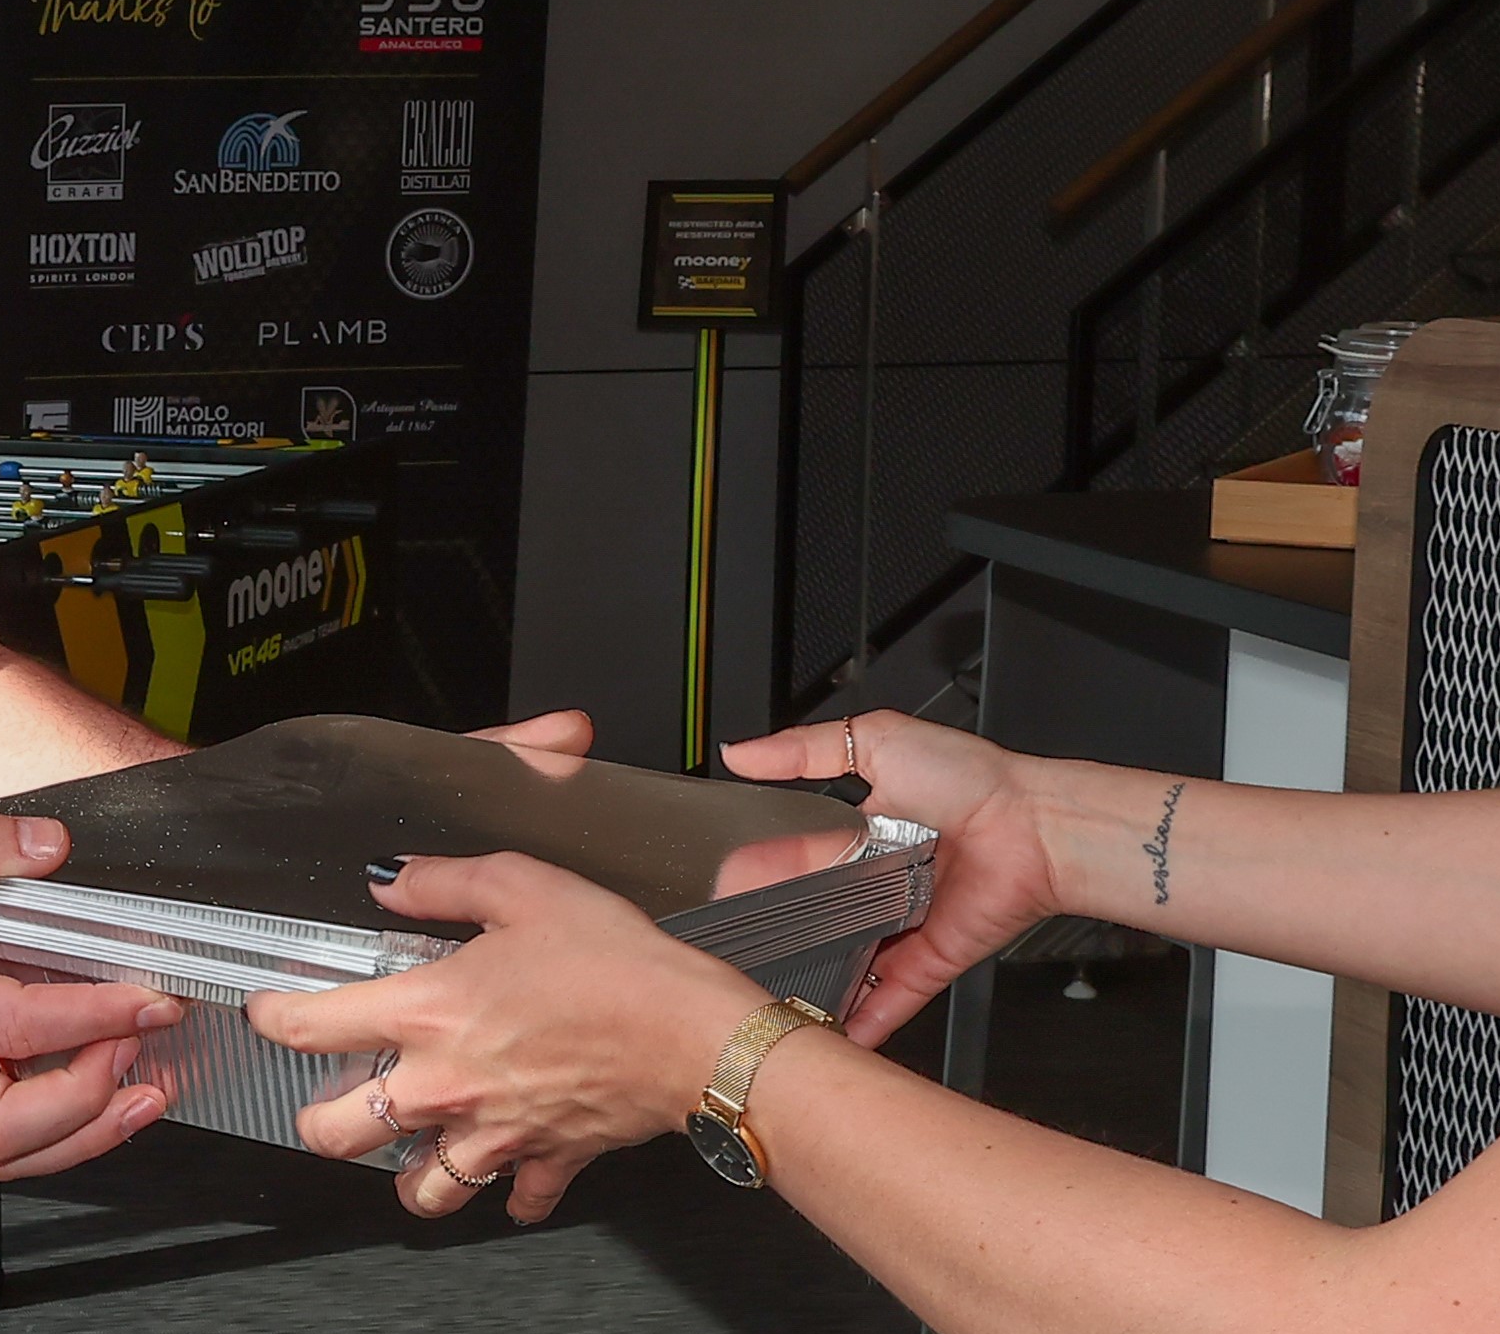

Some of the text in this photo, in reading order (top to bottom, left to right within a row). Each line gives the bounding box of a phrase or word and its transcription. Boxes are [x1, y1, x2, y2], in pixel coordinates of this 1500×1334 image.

[359, 17, 484, 36] SANTERO
[378, 39, 464, 51] ANALCOLICO
[30, 113, 137, 170] Cuzziol
[401, 99, 475, 167] CRACCO
[400, 173, 471, 190] DISTILLATI
[52, 186, 119, 198] CRAFT
[668, 220, 764, 229] RESTRICTED AREA
[675, 231, 756, 239] RESERVED FOR
[29, 232, 136, 265] HOXTON
[192, 224, 307, 280] WOLD TOP
[674, 255, 752, 270] mooney
[29, 271, 136, 284] SPIRITS LONDON
[166, 405, 230, 422] PAOLO
[166, 421, 265, 439] MURATORI
[226, 541, 340, 629] mooney
